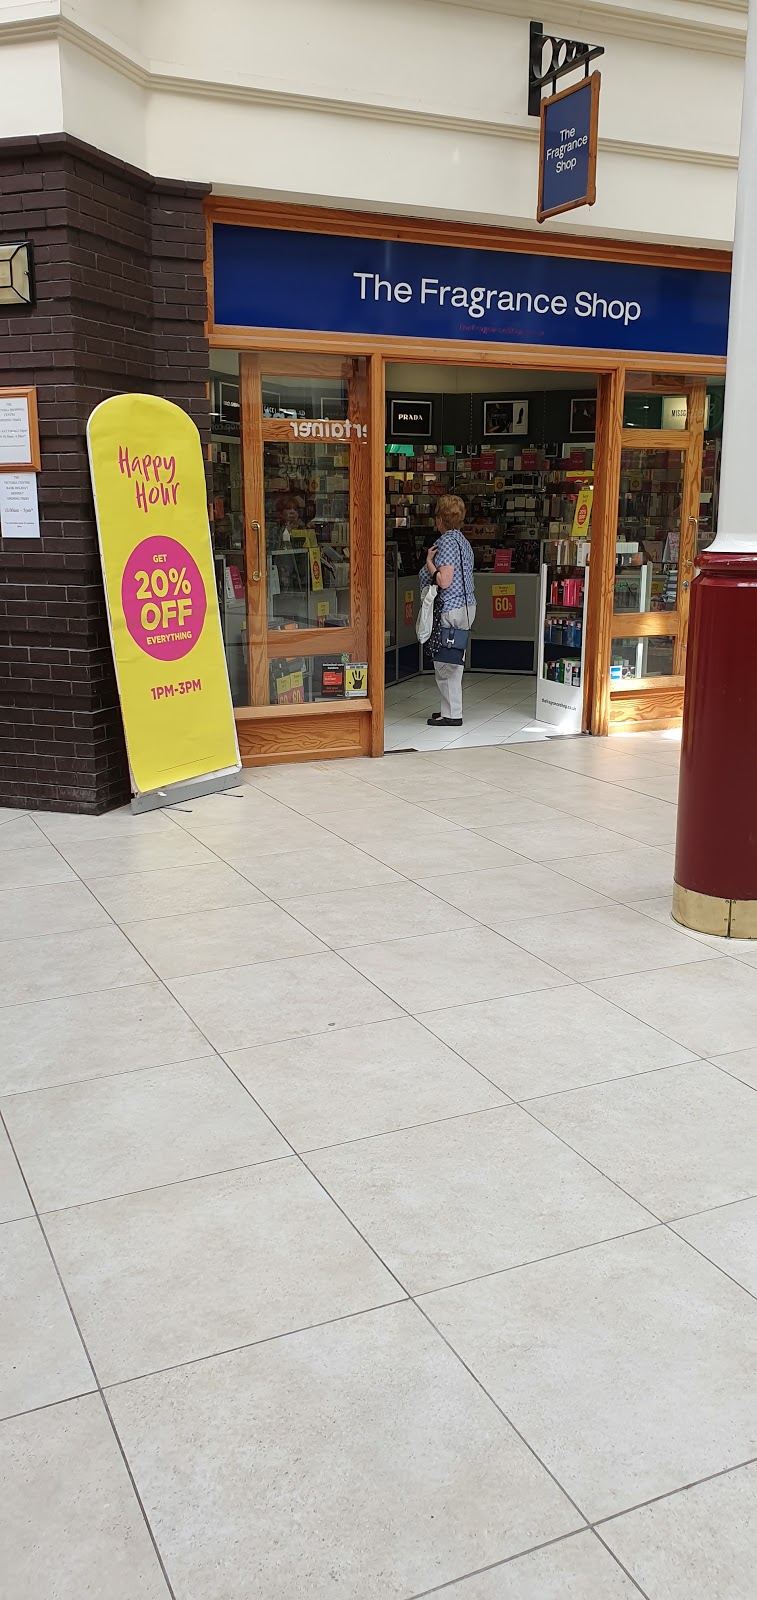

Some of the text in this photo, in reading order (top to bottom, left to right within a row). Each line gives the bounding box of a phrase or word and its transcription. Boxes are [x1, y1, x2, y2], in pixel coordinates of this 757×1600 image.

[560, 127, 576, 142] The
[546, 135, 588, 160] Fragrance
[556, 158, 576, 174] Shop
[353, 271, 642, 326] The Fragrance Shop
[398, 413, 424, 421] PRADA
[672, 409, 686, 417] MISSG
[118, 445, 176, 484] Happy
[135, 480, 180, 513] Hour
[152, 554, 168, 564] GET
[134, 568, 192, 600] 20%
[140, 598, 193, 632] OFF
[146, 630, 193, 646] EVERYTHING
[150, 678, 202, 700] 1PM-3PM
